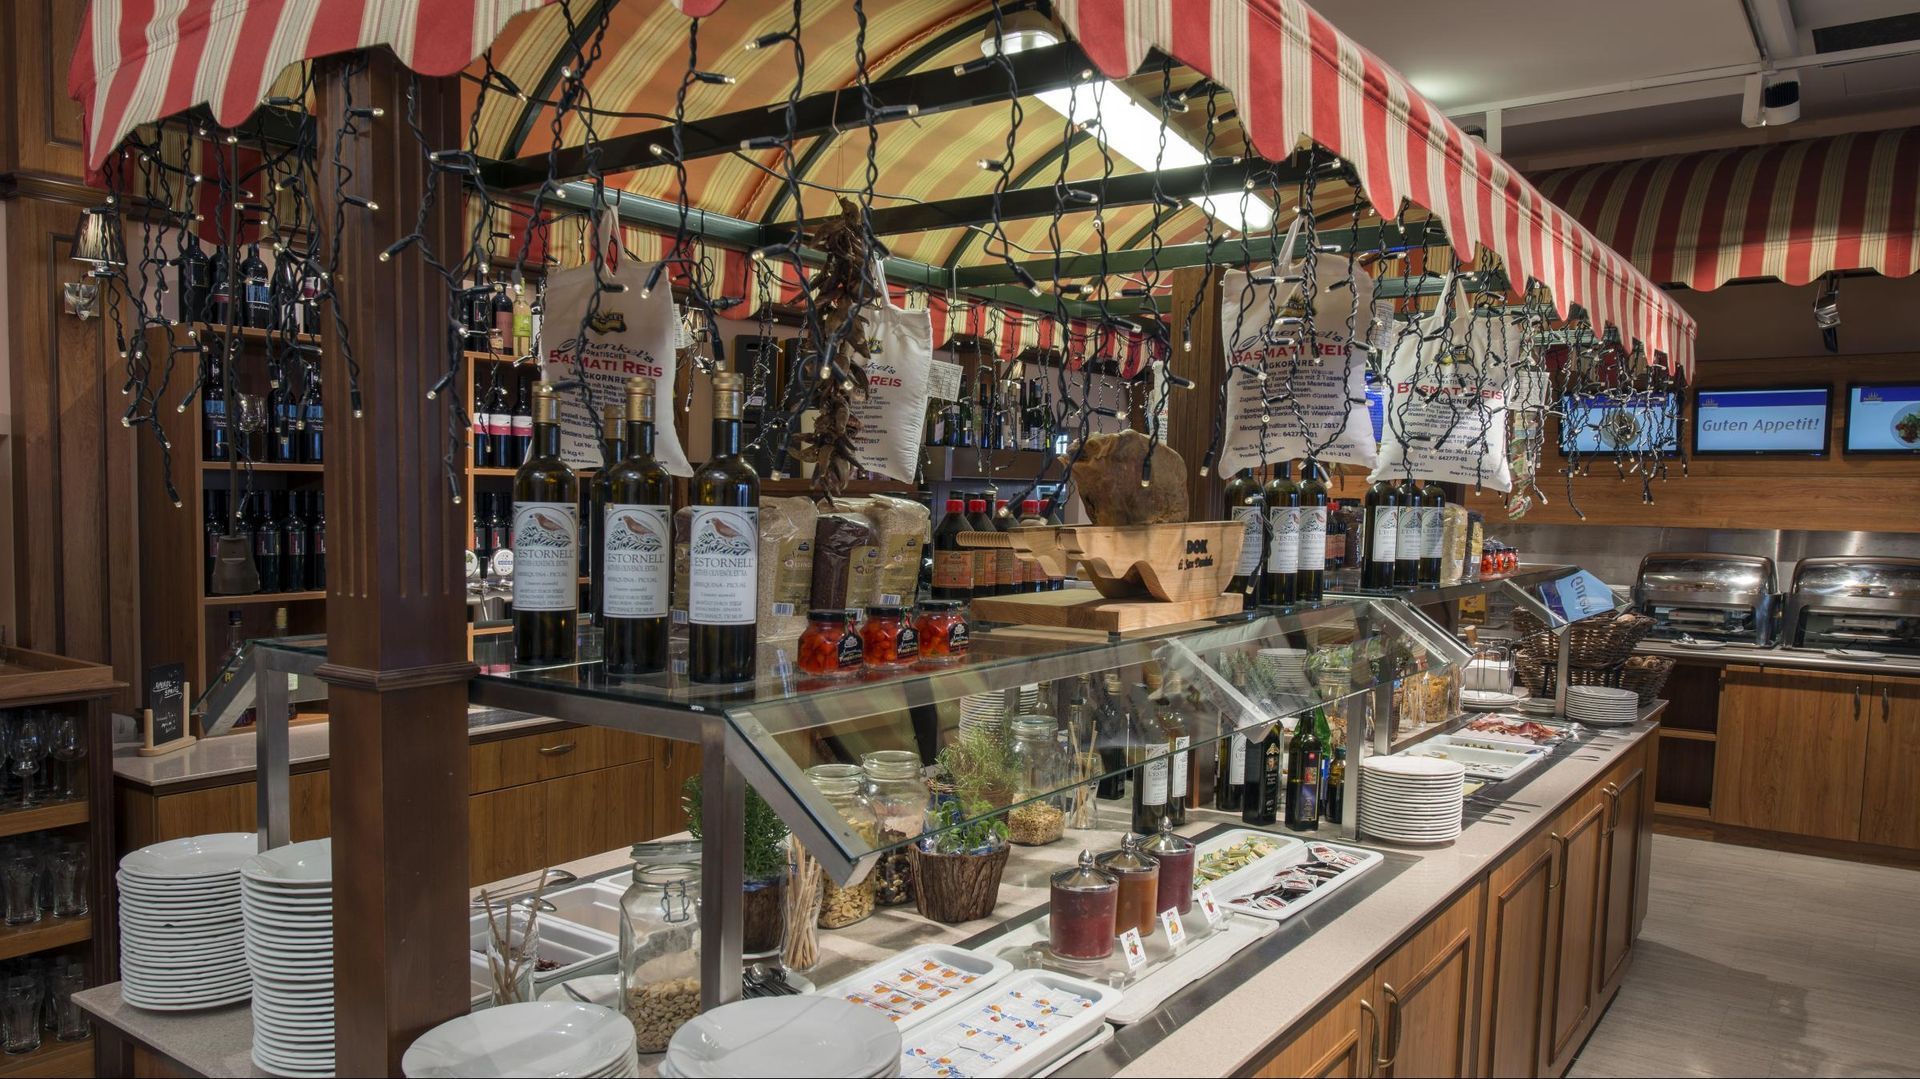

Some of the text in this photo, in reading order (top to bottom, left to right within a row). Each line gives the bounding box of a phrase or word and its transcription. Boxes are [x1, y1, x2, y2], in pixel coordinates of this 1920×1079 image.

[623, 360, 663, 377] REIS
[870, 375, 902, 387] REIS
[1702, 417, 1819, 434] Guten Appetit!
